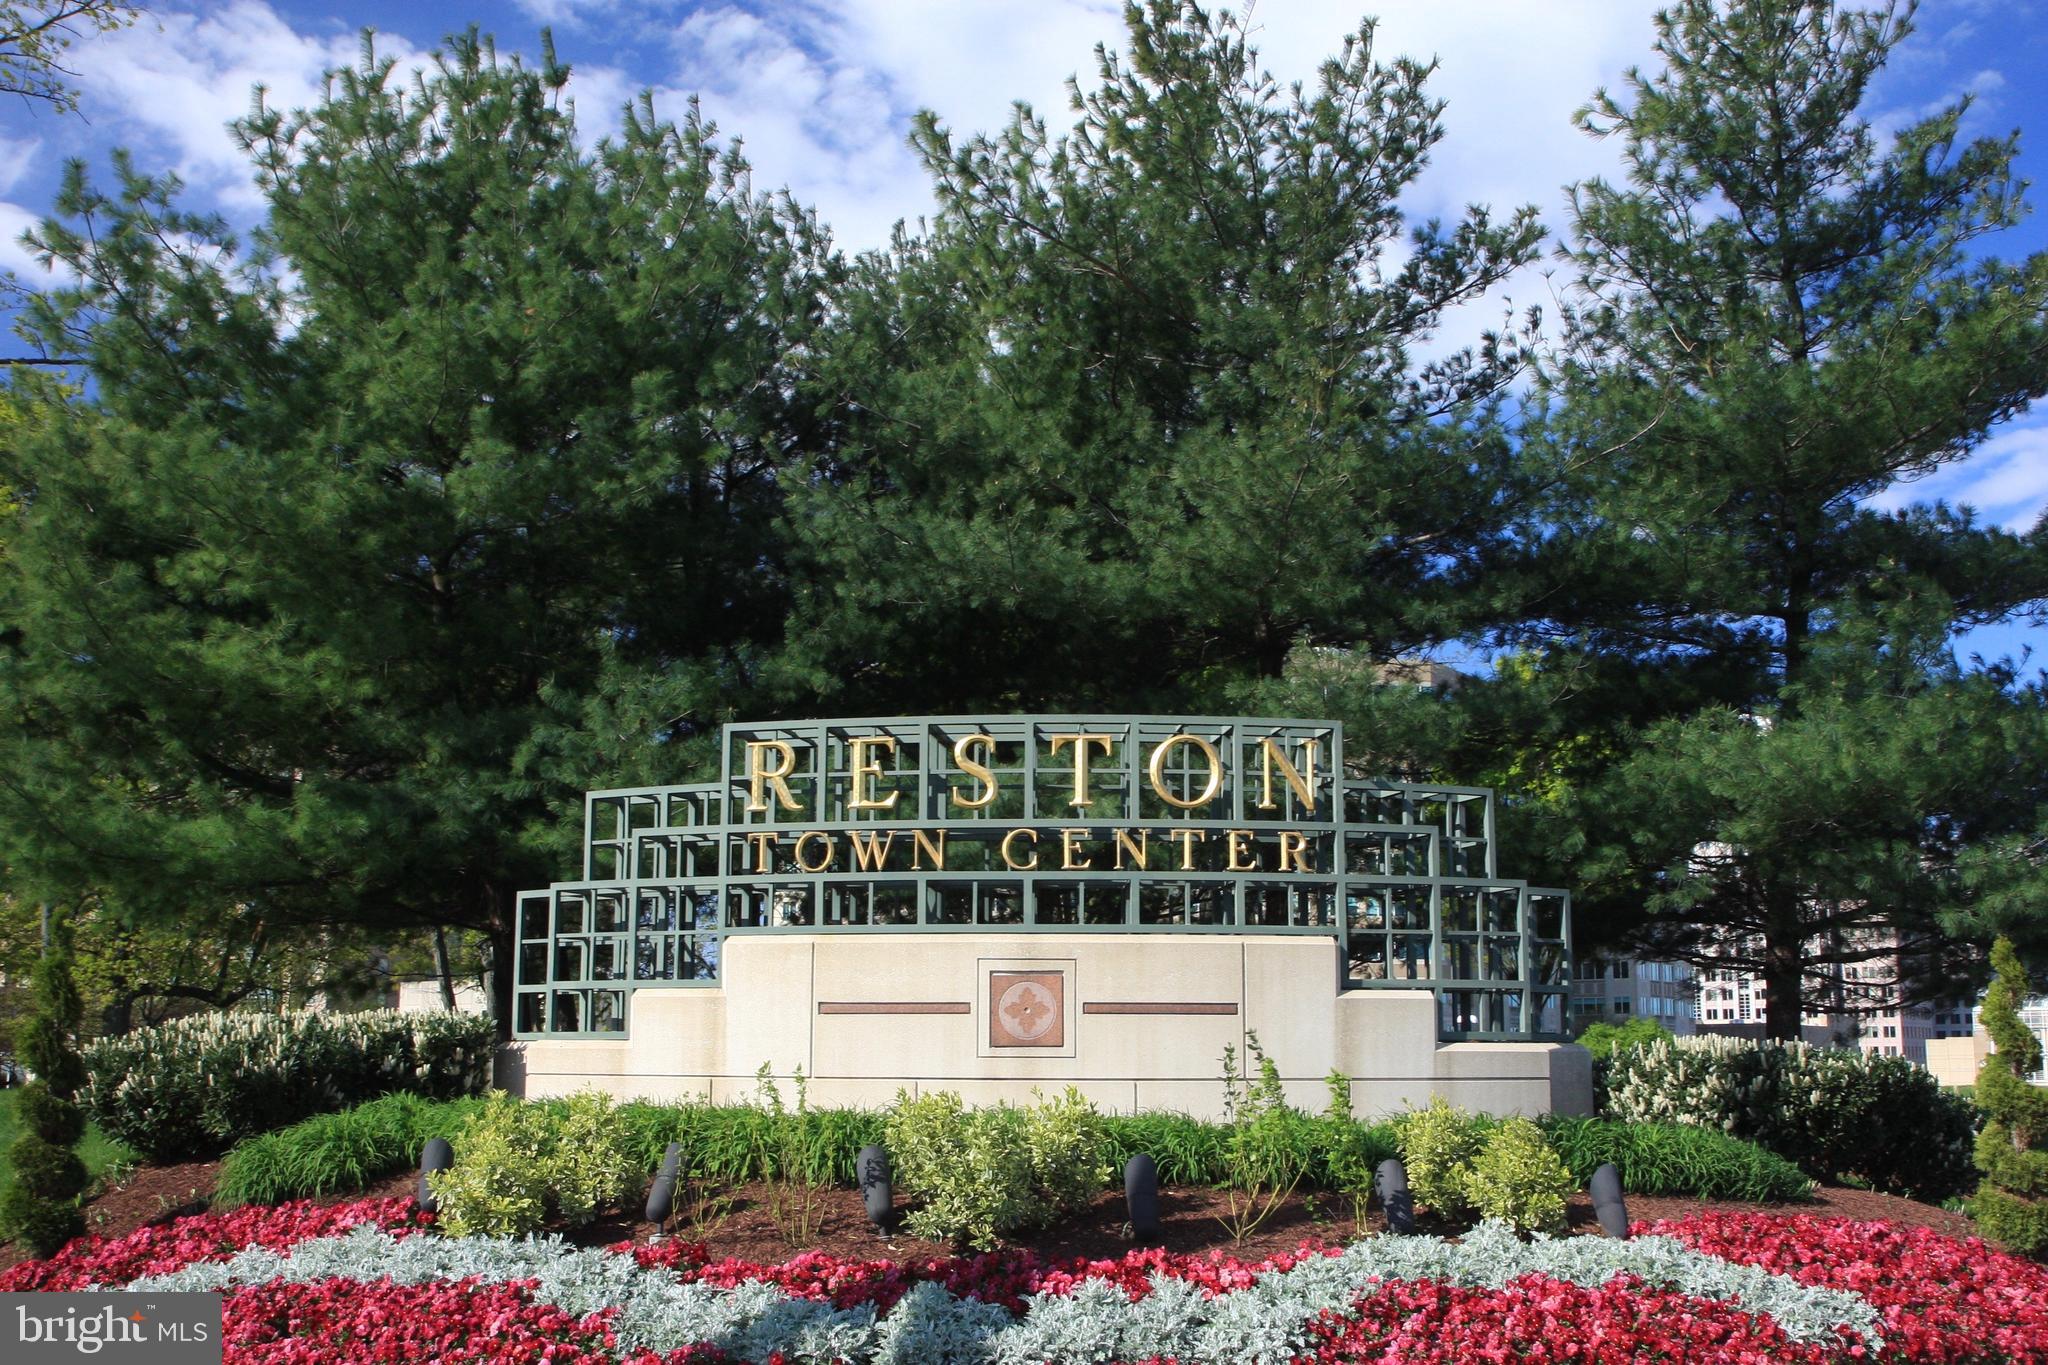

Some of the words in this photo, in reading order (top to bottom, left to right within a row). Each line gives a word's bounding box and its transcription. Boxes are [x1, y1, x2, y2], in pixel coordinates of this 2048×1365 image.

[746, 734, 1319, 812] RESTON
[748, 829, 947, 873] TOWN
[1001, 828, 1316, 873] CENTER
